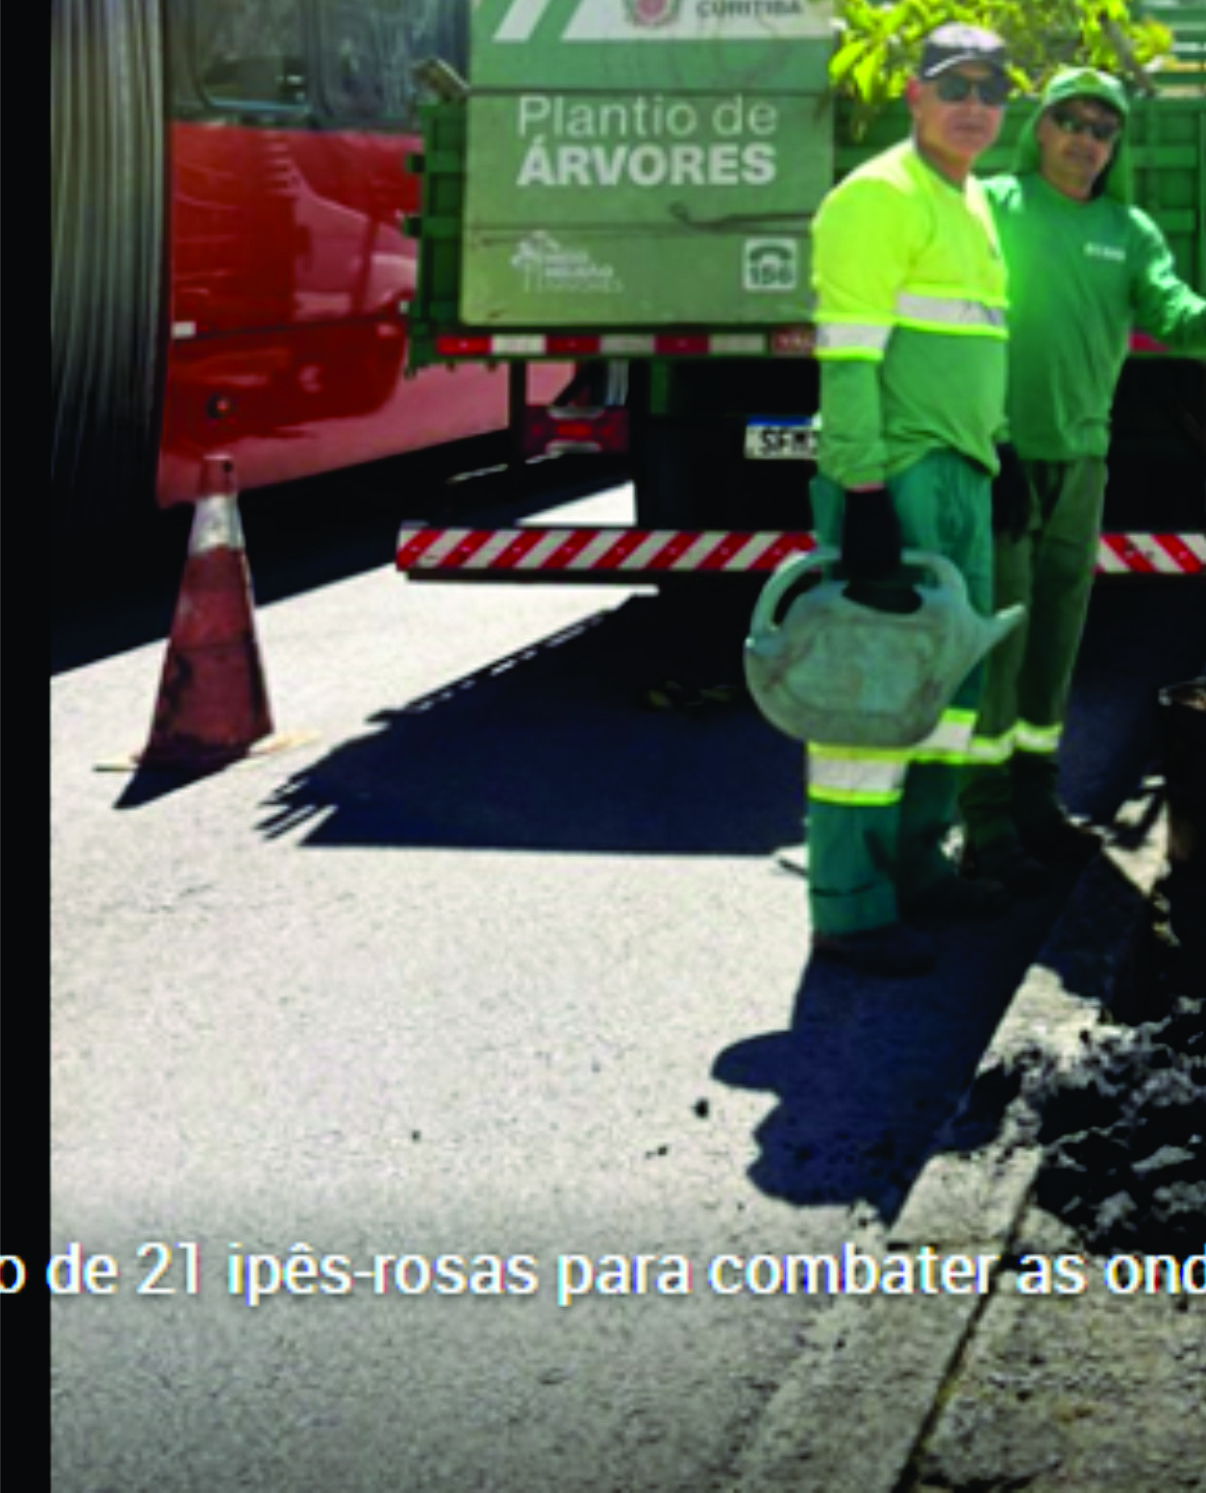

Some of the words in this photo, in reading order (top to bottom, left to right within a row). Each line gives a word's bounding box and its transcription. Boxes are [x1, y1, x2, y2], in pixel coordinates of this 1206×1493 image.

[518, 95, 697, 137] Plantio
[712, 95, 778, 137] de
[516, 134, 777, 187] ÁRVORES
